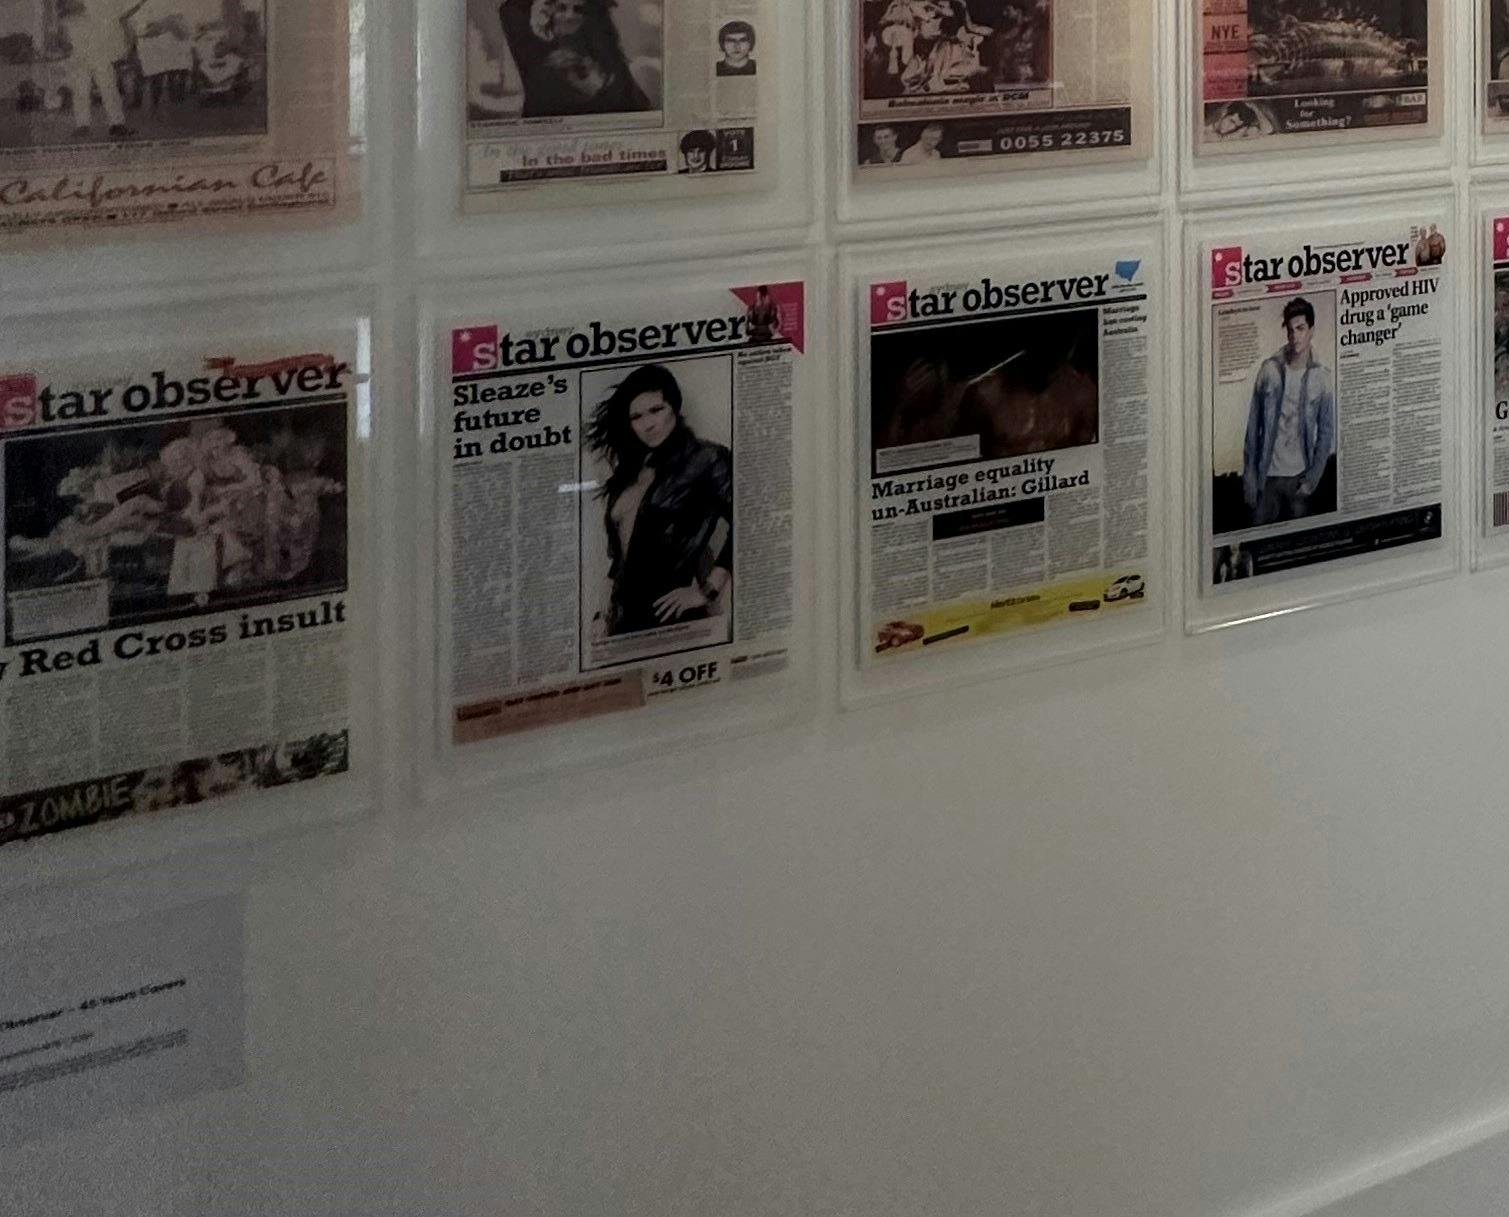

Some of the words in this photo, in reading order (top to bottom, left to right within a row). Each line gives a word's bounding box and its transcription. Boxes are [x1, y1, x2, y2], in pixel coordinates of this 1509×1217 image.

[1212, 25, 1239, 40] NYE
[1294, 97, 1335, 109] Looking
[1285, 115, 1352, 131] Something?
[1000, 134, 1053, 150] 0055
[1061, 129, 1124, 146] 22375
[546, 152, 573, 166] the
[581, 149, 612, 163] bad
[619, 148, 667, 161] times
[1225, 253, 1283, 286] star
[1288, 244, 1410, 278] observer
[886, 289, 956, 321] star
[963, 272, 1110, 311] observer
[1340, 284, 1410, 307] Approved
[1412, 278, 1440, 296] HIV
[1103, 305, 1139, 315] Marriage
[1340, 309, 1374, 327] drug
[1377, 310, 1385, 321] a
[473, 331, 560, 370] star
[566, 315, 748, 358] observer
[1, 382, 113, 425] star
[122, 360, 350, 414] observer
[453, 375, 568, 407] Sleaze's
[453, 408, 541, 432] future
[453, 438, 483, 459] in
[489, 426, 573, 454] doubt
[871, 469, 969, 500] Marriage
[975, 457, 1056, 484] equality
[871, 485, 1018, 522] un-Australian:
[1021, 471, 1091, 498] Gillard
[20, 640, 102, 677] Red
[114, 623, 227, 660] Cross
[239, 600, 347, 639] insult
[653, 670, 674, 687] $4
[679, 661, 718, 684] OFF
